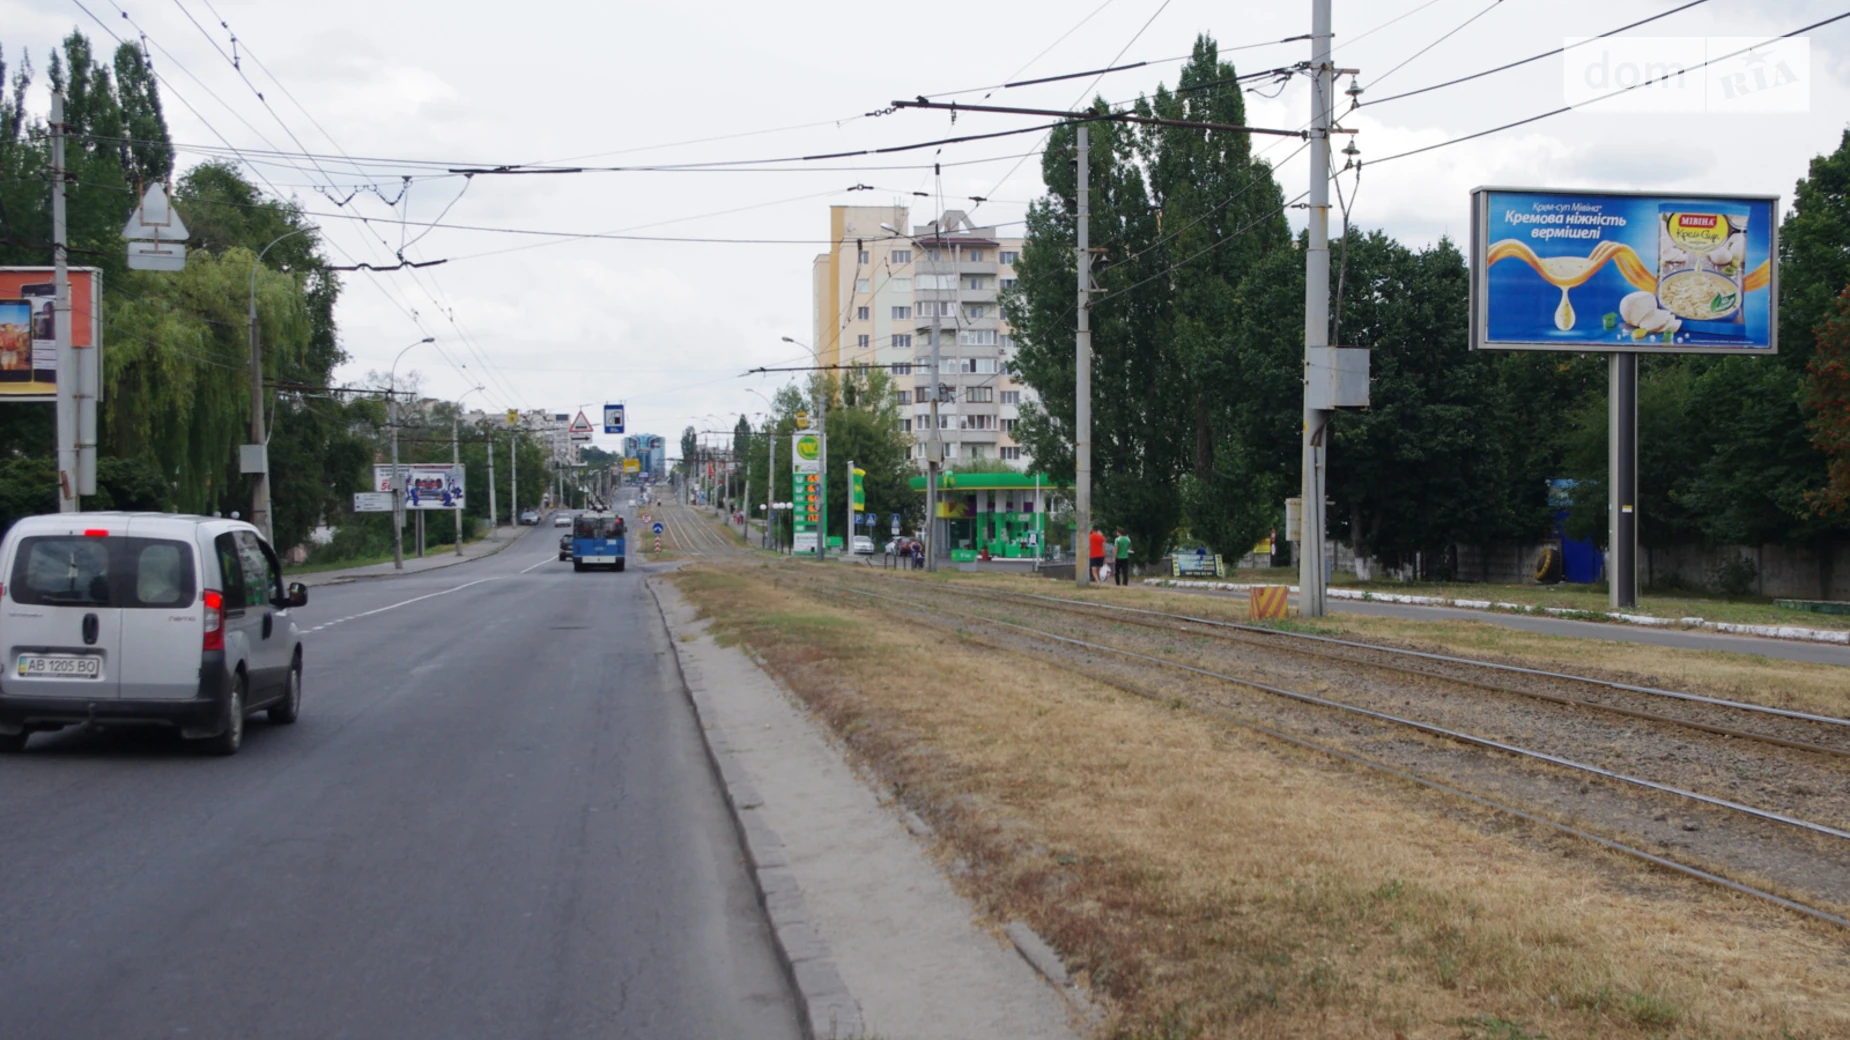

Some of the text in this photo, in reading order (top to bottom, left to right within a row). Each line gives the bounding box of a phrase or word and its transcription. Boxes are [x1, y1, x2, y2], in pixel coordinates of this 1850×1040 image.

[1532, 202, 1571, 213] Крем-суп
[1504, 210, 1627, 227] Кремова ніжність
[1531, 225, 1602, 241] вермішелі
[49, 660, 74, 672] 1205
